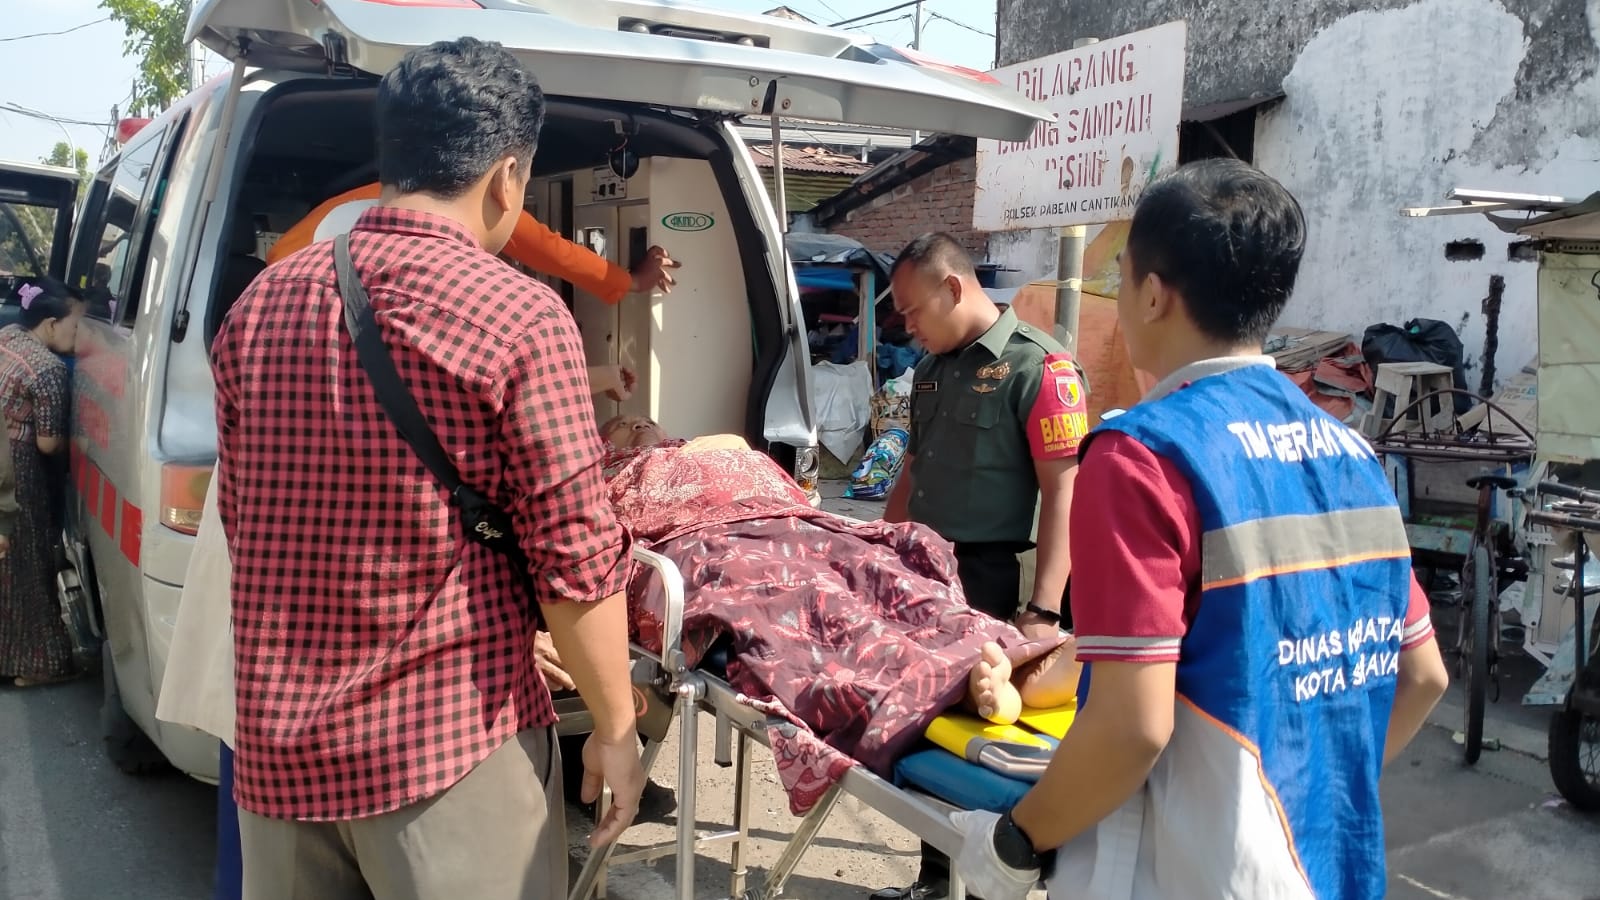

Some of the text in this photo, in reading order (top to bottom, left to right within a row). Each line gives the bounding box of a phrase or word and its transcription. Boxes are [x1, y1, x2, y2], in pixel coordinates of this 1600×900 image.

[1067, 93, 1153, 144] SAMPAH
[1003, 205, 1037, 221] POLSEK
[1040, 200, 1077, 217] PABEAN
[1277, 629, 1344, 666] DINAS
[1294, 666, 1347, 703] KOTA
